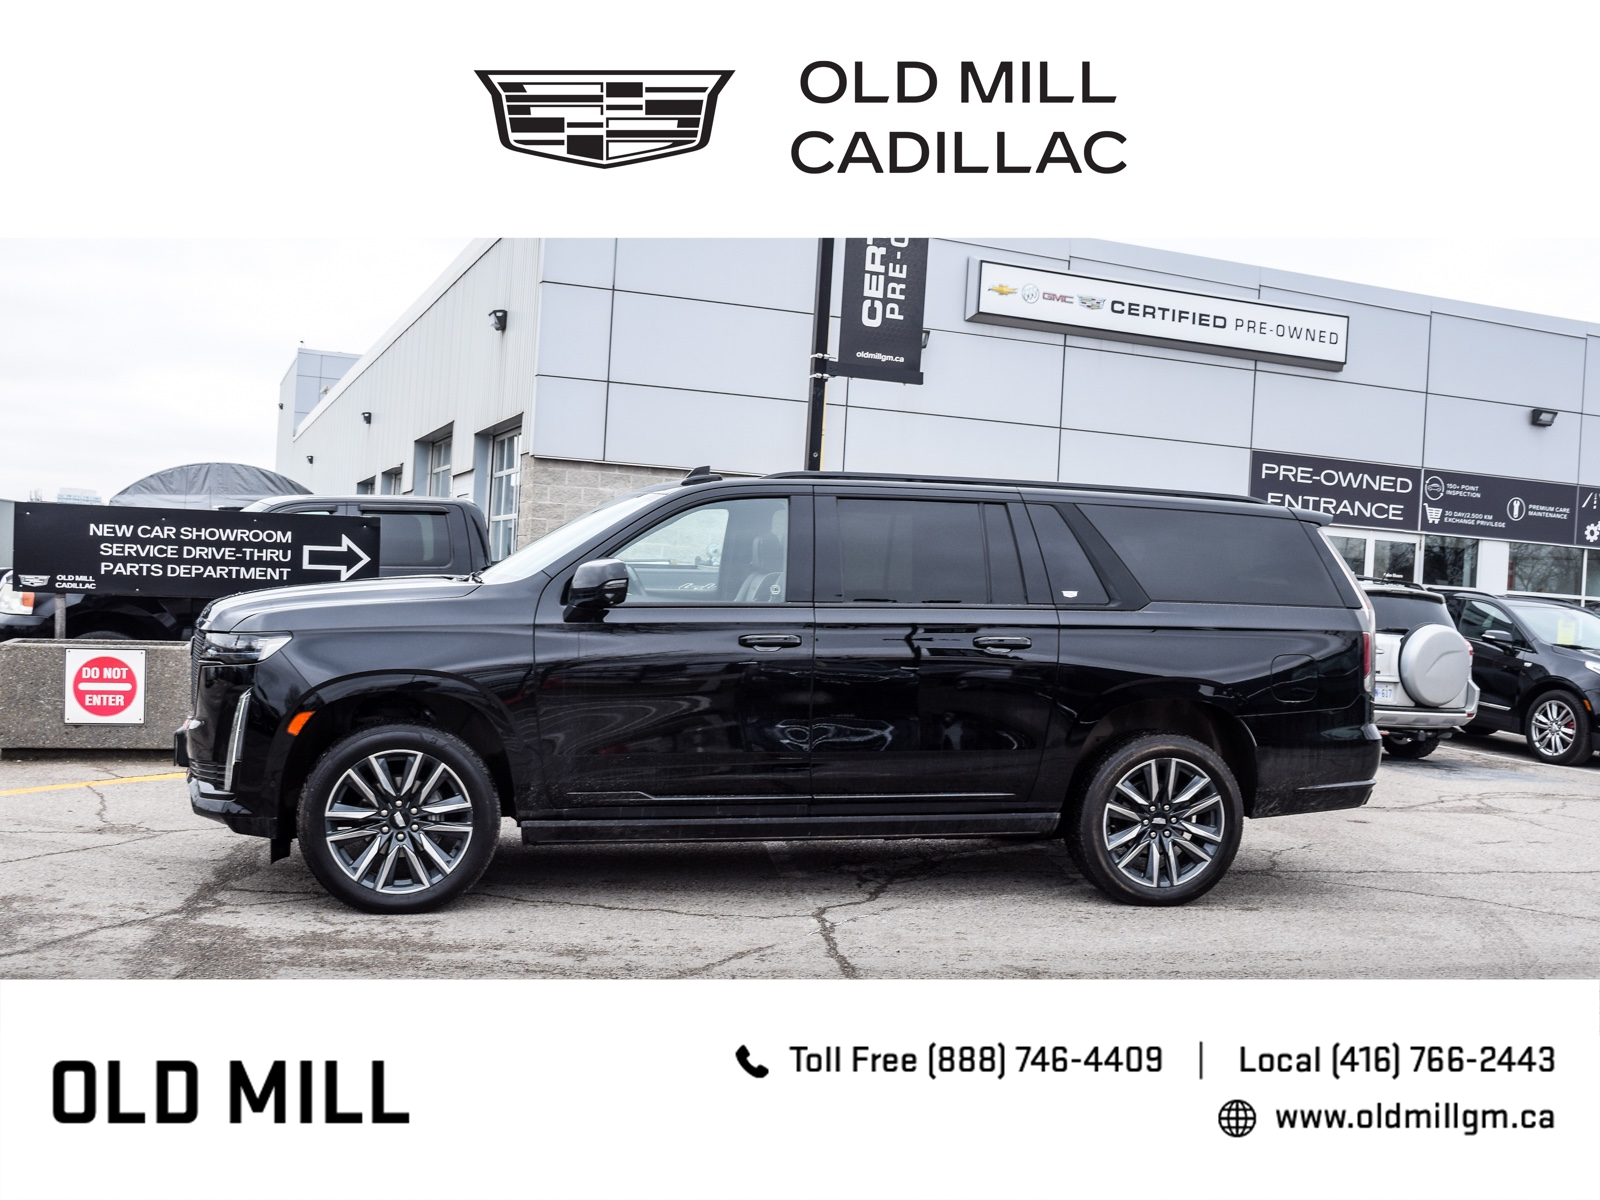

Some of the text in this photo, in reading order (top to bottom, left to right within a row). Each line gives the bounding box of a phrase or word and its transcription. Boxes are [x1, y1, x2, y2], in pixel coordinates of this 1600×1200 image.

[1042, 292, 1339, 346] GMC CERTIFIED PRE-OWNED
[856, 350, 905, 363] oldmillgm.ca
[1261, 463, 1413, 494] PRE-OWNED
[1446, 490, 1481, 498] INSPECTION
[1461, 484, 1479, 492] POINT
[1267, 492, 1404, 521] ENTRANCE
[1528, 504, 1570, 514] PREMIUM CARE
[1528, 511, 1568, 519] MAINTENANCE
[1444, 517, 1506, 528] EXCHANGE PRIVILEGE
[89, 523, 292, 544] NEW CAR SHOWROOM
[99, 543, 292, 562] SERVICE DRIVE-THRU
[100, 562, 292, 581] PARTS DEPARTMENT
[56, 574, 95, 583] OLD MILL
[55, 582, 97, 590] CADILLAC
[81, 666, 129, 680] DO NOT
[84, 694, 125, 707] ENTER
